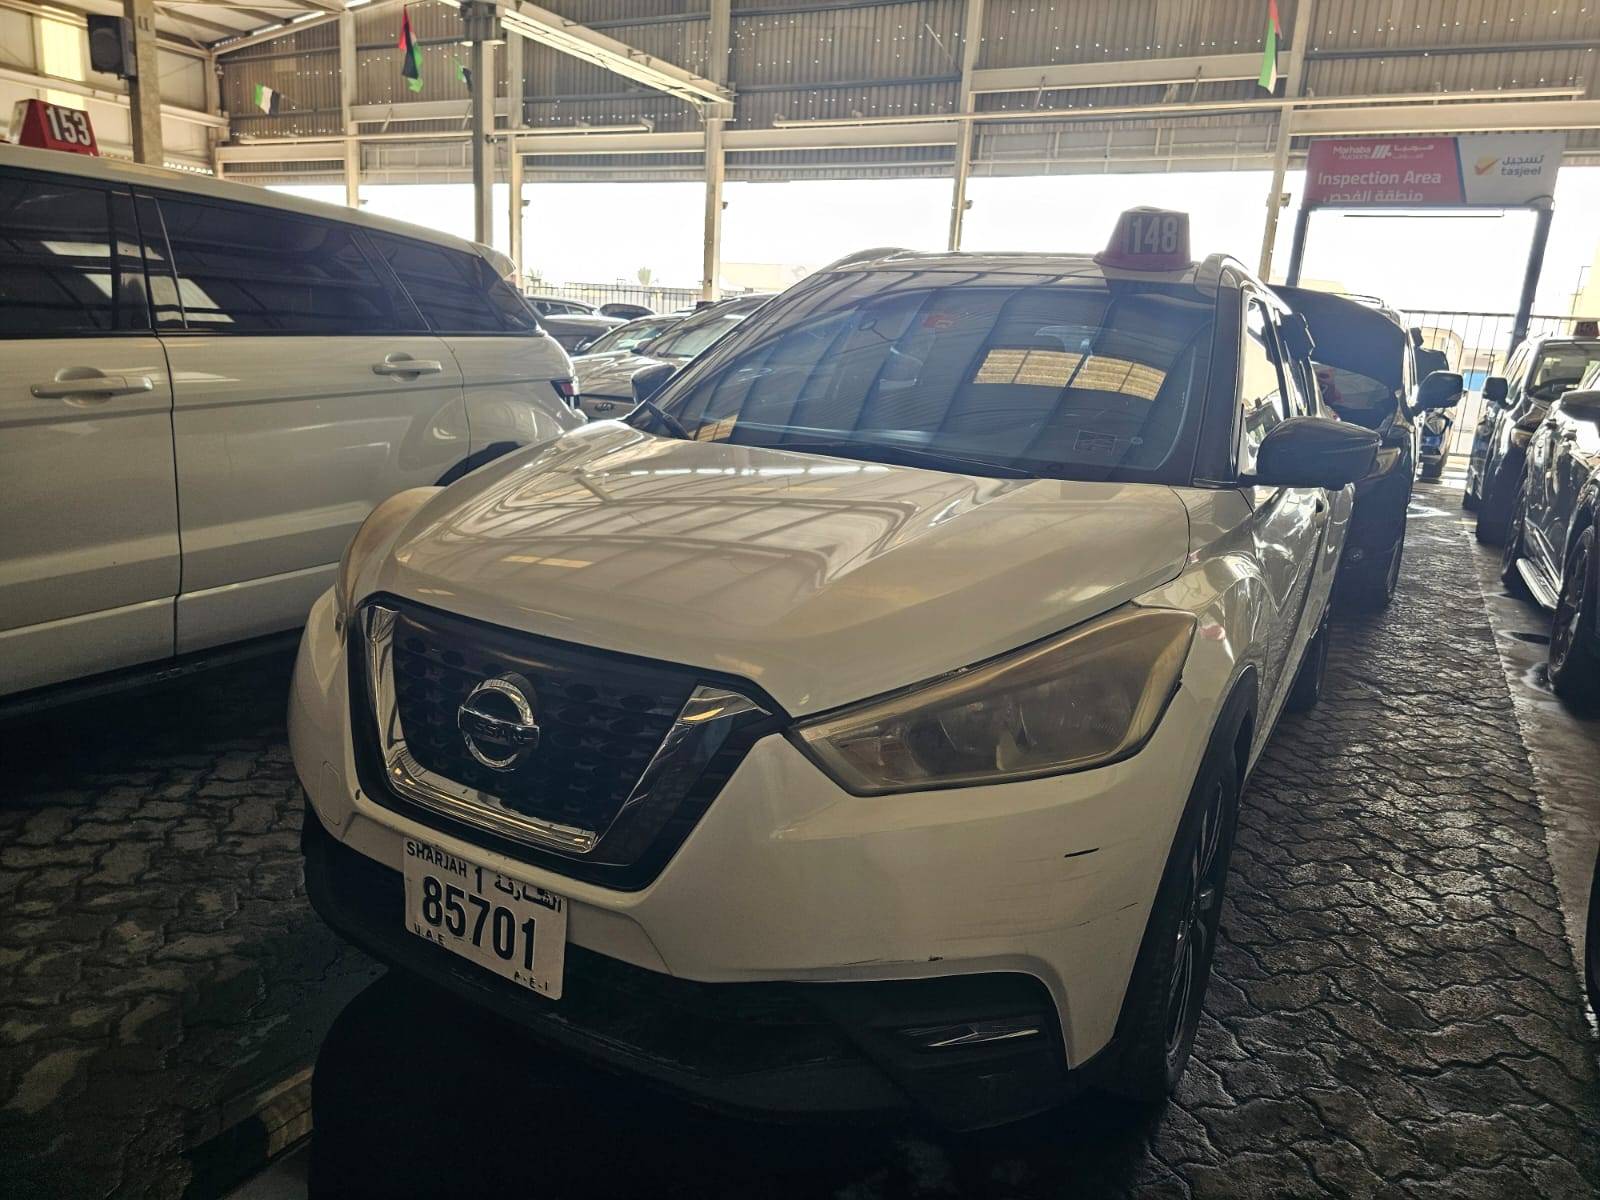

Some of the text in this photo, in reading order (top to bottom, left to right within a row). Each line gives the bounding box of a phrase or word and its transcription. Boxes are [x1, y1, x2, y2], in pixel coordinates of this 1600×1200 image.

[47, 106, 91, 146] 153
[1318, 170, 1442, 188] Inspection Area
[1501, 166, 1542, 177] tasjeel
[1129, 216, 1178, 253] 148
[406, 841, 468, 878] SHARJAH
[475, 866, 483, 894] 1
[422, 875, 536, 972] 85701
